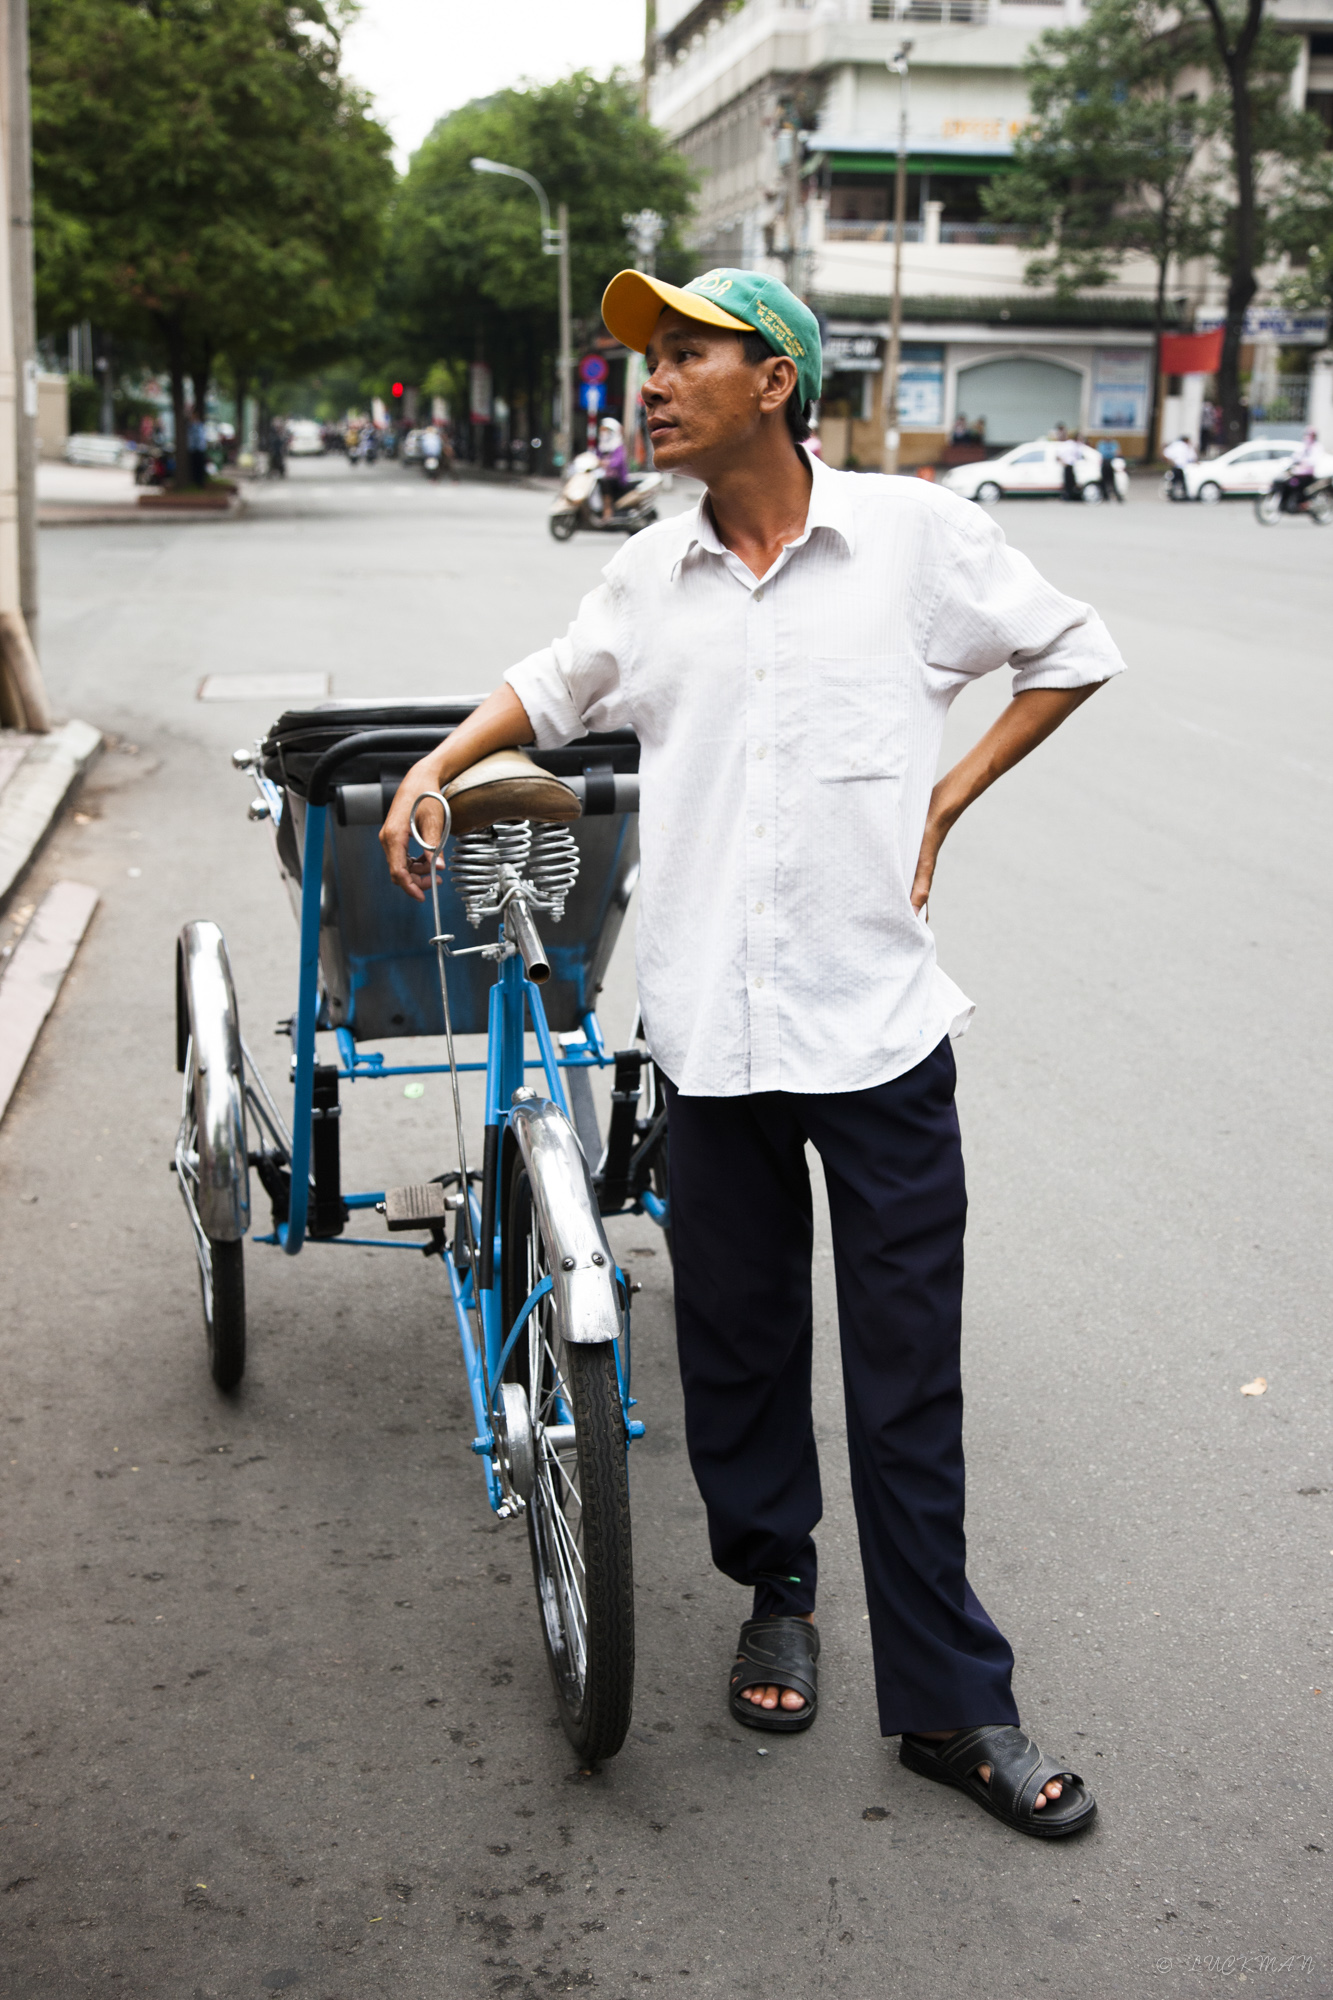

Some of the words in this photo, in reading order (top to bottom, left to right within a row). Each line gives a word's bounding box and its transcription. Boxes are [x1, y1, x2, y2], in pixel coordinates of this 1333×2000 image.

[760, 317, 775, 333] THAN
[776, 333, 784, 341] OF
[773, 322, 786, 337] LAWS
